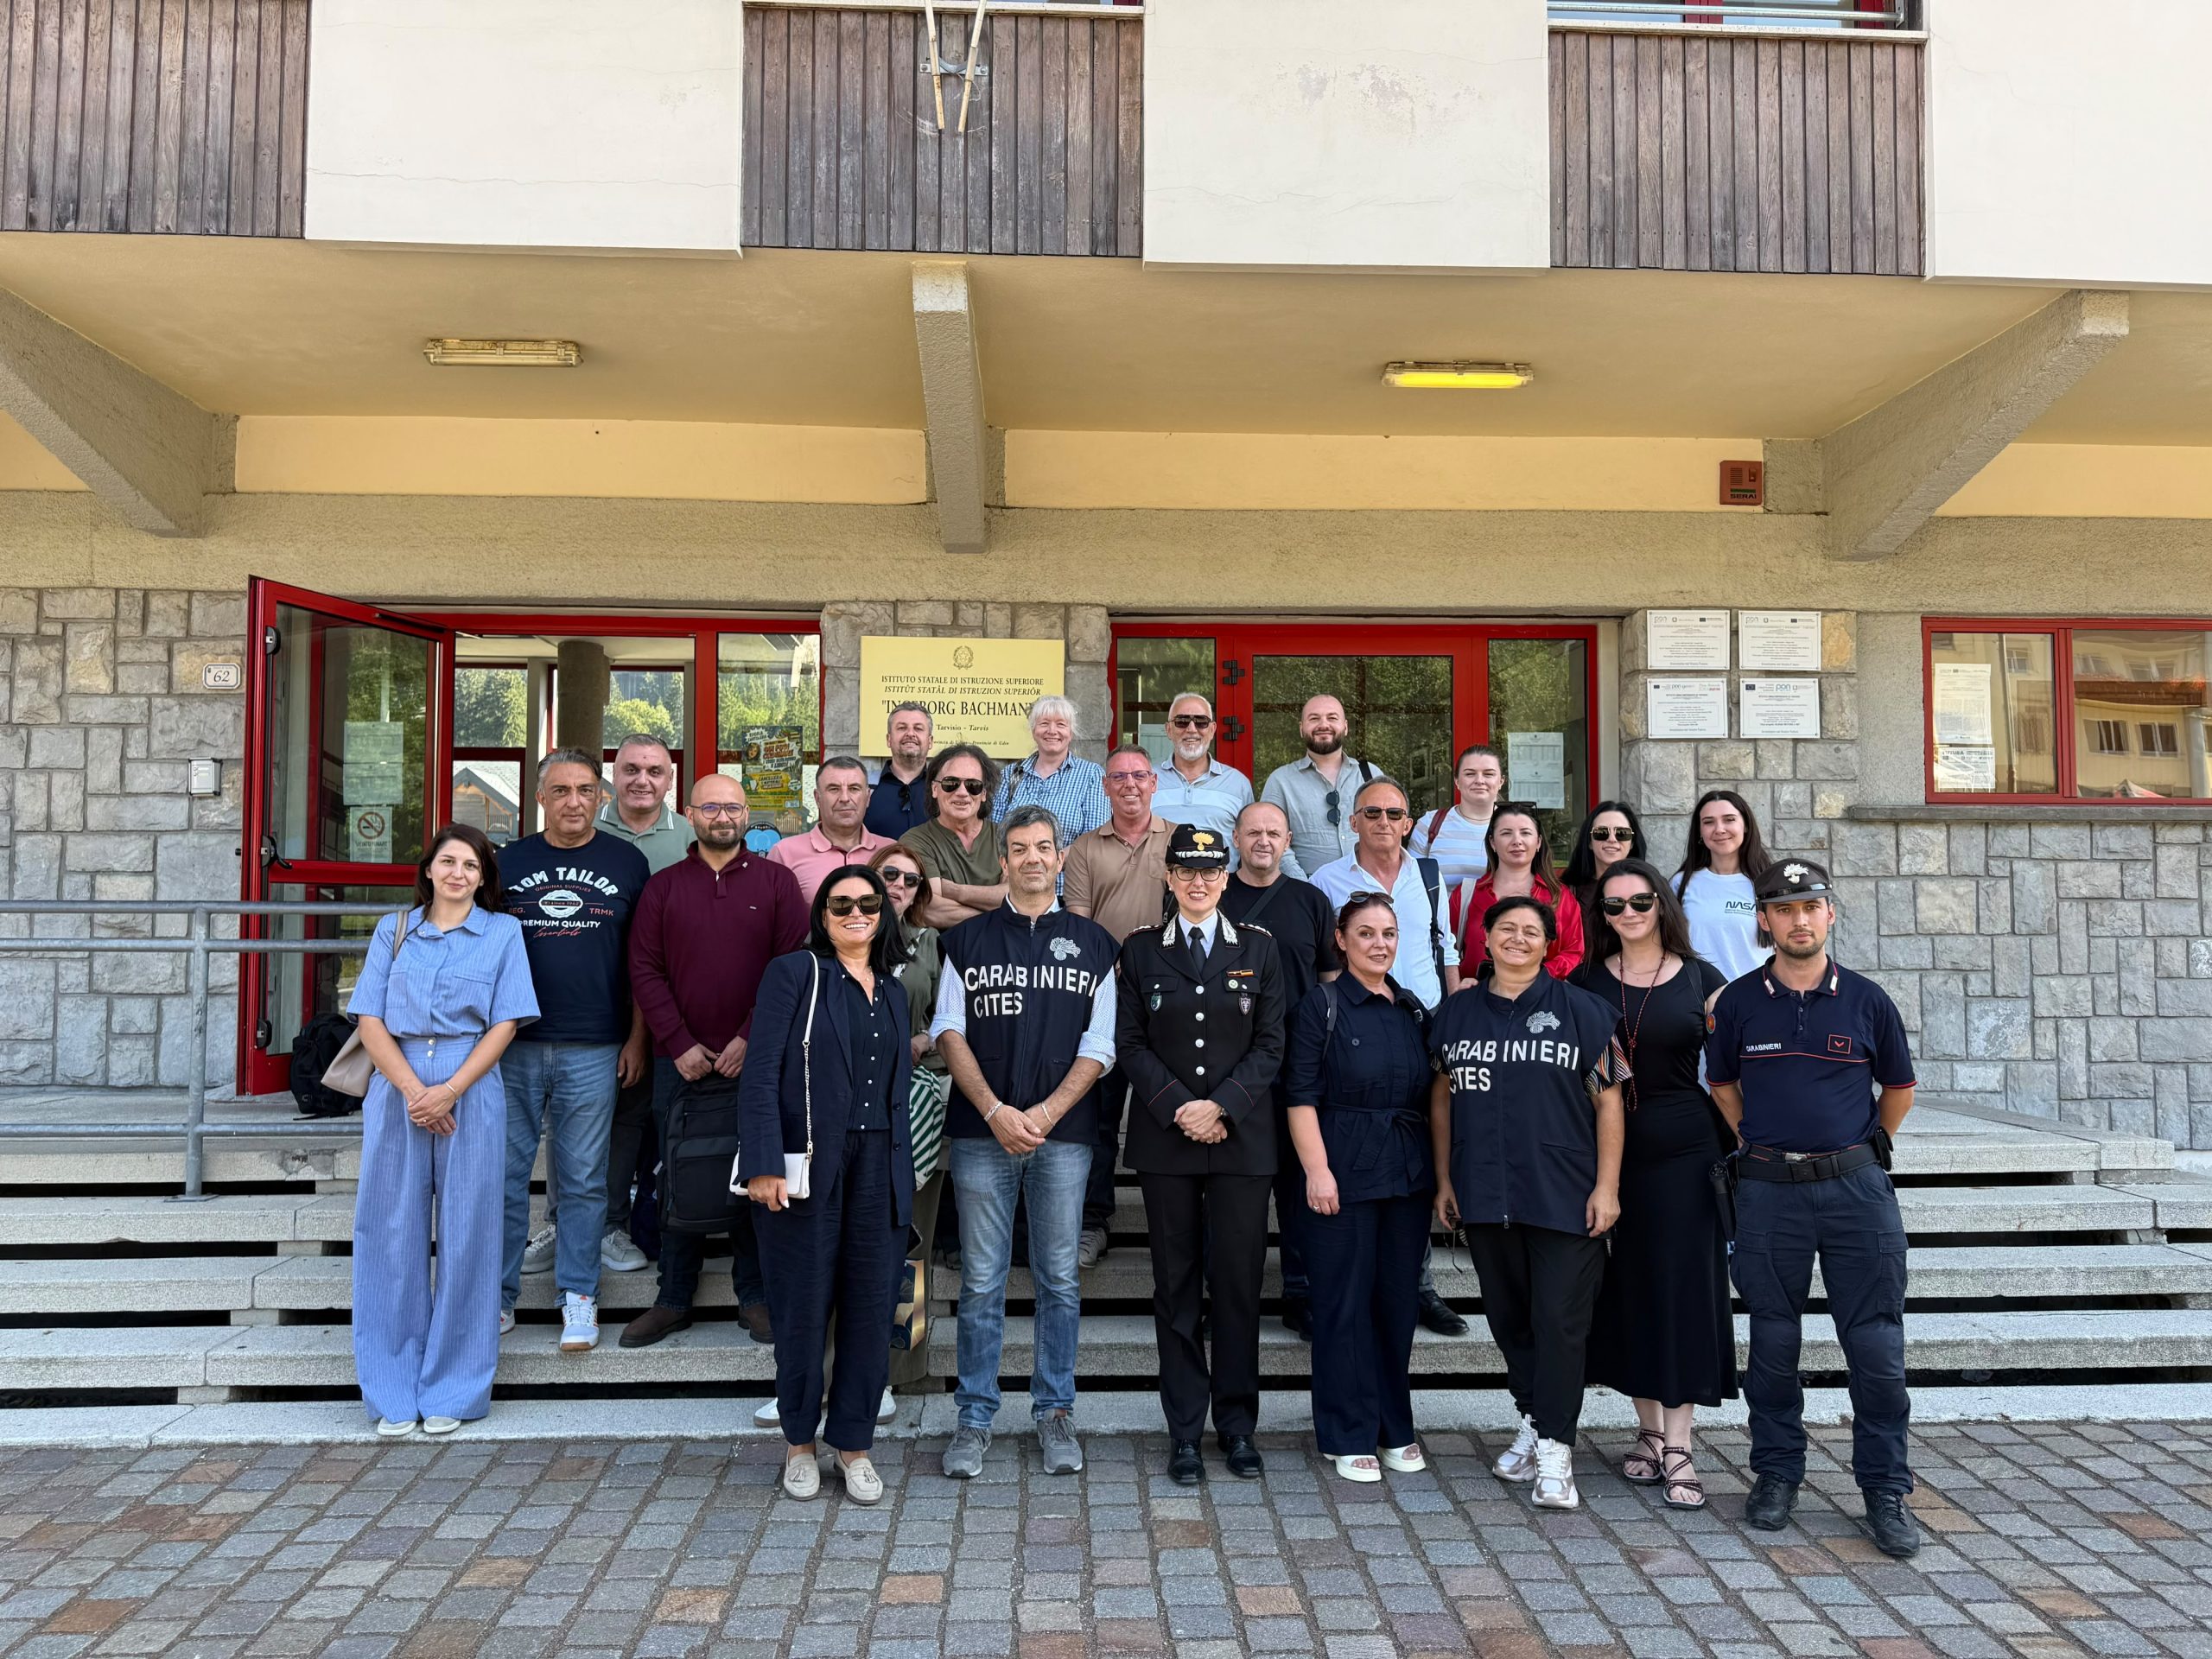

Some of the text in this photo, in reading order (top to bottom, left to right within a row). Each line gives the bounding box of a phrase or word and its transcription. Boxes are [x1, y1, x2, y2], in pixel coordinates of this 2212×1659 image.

[213, 670, 230, 683] 62
[881, 675, 916, 683] ISTITUTO
[918, 676, 948, 684] STATALE
[960, 702, 1033, 716] BACHMAN
[508, 867, 619, 896] TOM TAILOR
[588, 907, 614, 916] TRMK
[561, 919, 601, 929] QUALITY
[974, 992, 1023, 1019] CITES
[1745, 1042, 1782, 1052] CARABINIERI
